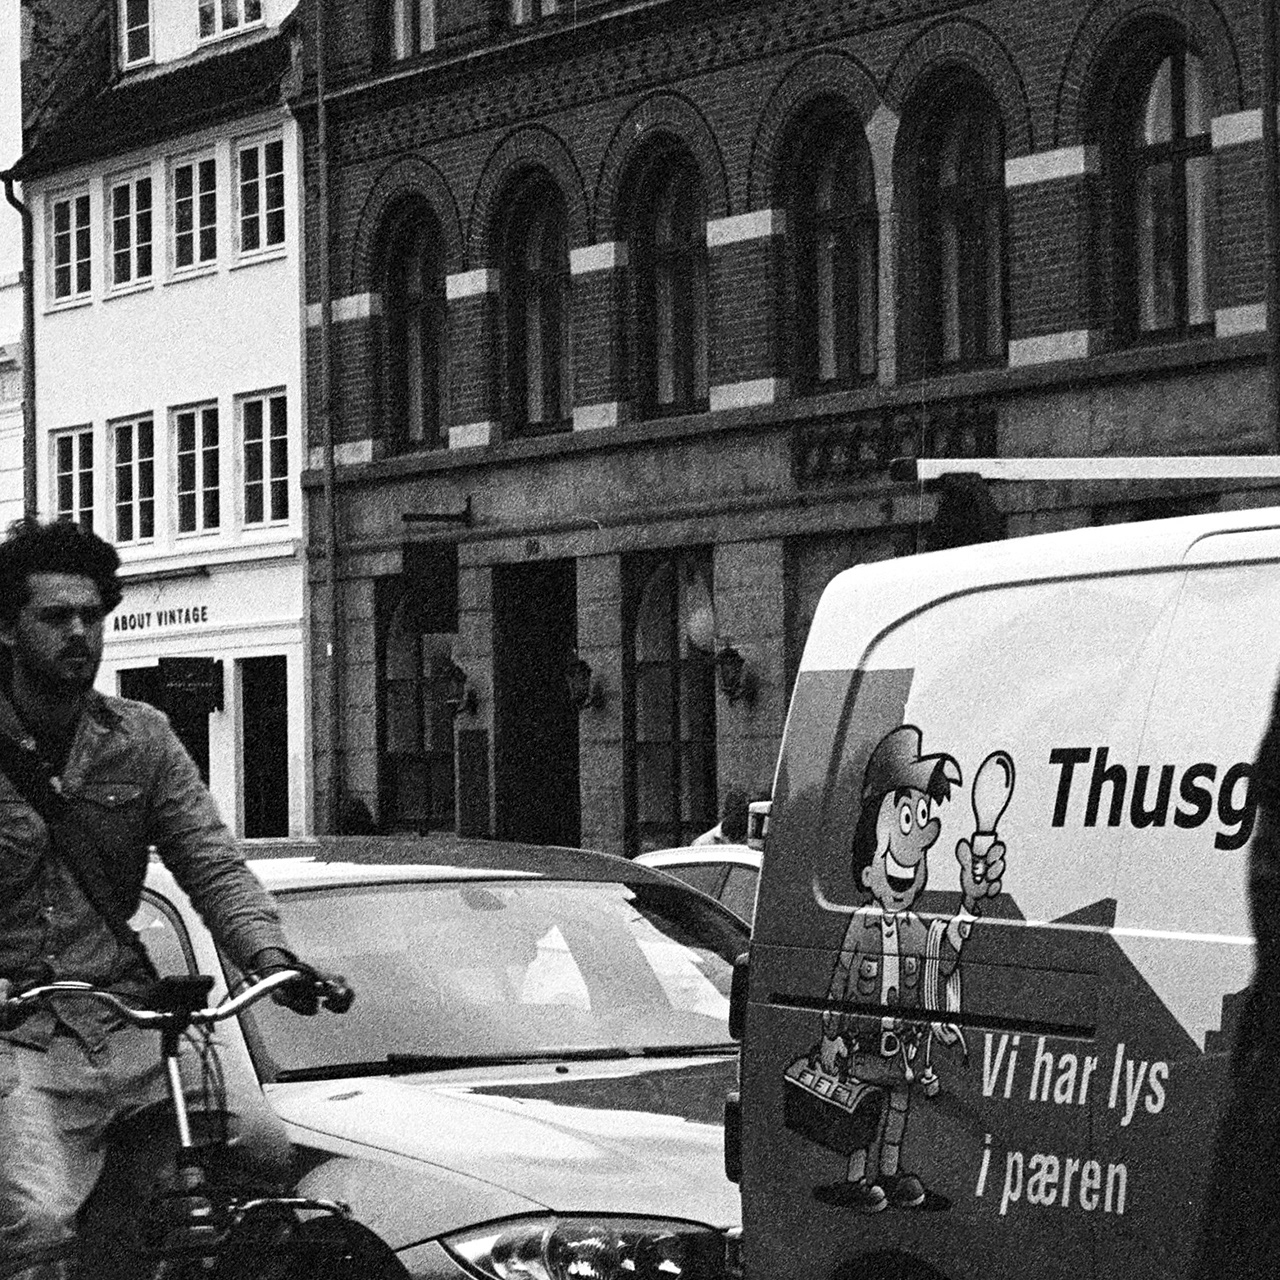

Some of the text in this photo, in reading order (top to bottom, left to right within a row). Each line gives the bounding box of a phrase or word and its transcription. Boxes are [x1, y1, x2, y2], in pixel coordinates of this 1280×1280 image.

[113, 606, 209, 632] ABOUT VINTAGE
[982, 1033, 1169, 1126] Vi har lys
[975, 1133, 1128, 1215] i pæren
